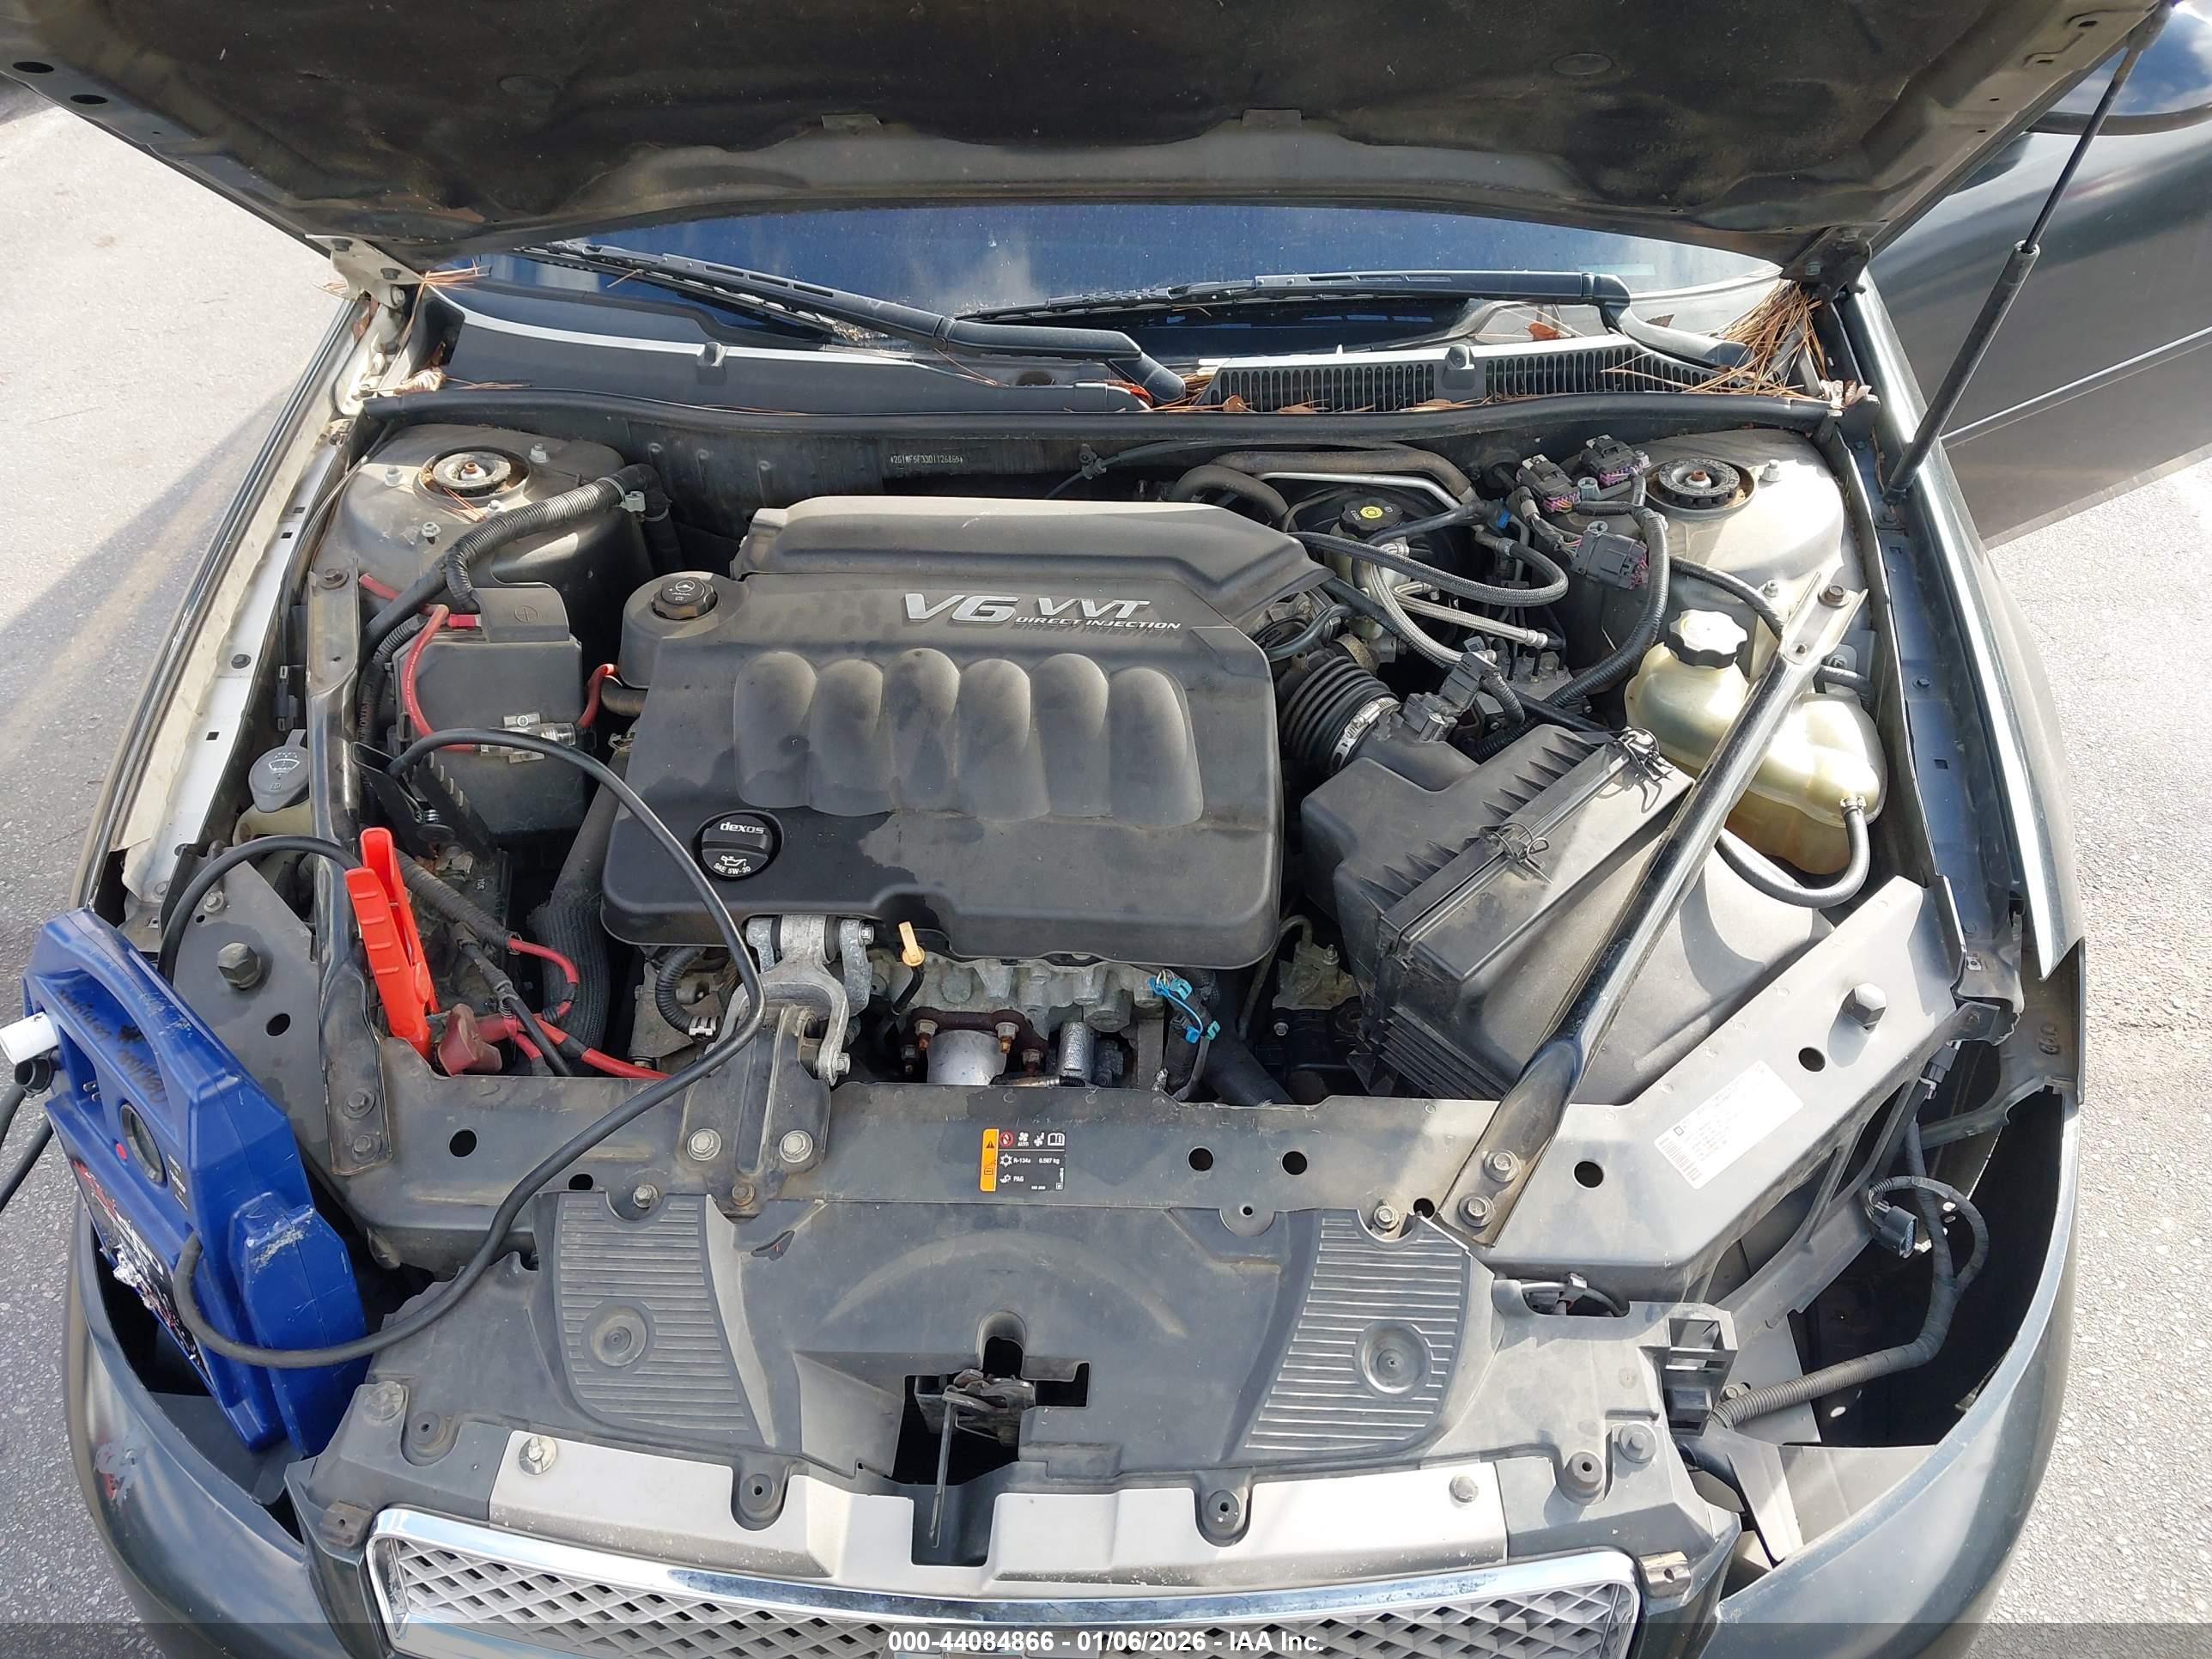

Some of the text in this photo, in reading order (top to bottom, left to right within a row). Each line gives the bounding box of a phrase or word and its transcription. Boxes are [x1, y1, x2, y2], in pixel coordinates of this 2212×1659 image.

[904, 592, 1151, 624] V6 VVT
[1015, 616, 1182, 630] DIRECT INJECTION
[720, 822, 765, 834] dexos
[714, 862, 751, 874] SAE 5W-30
